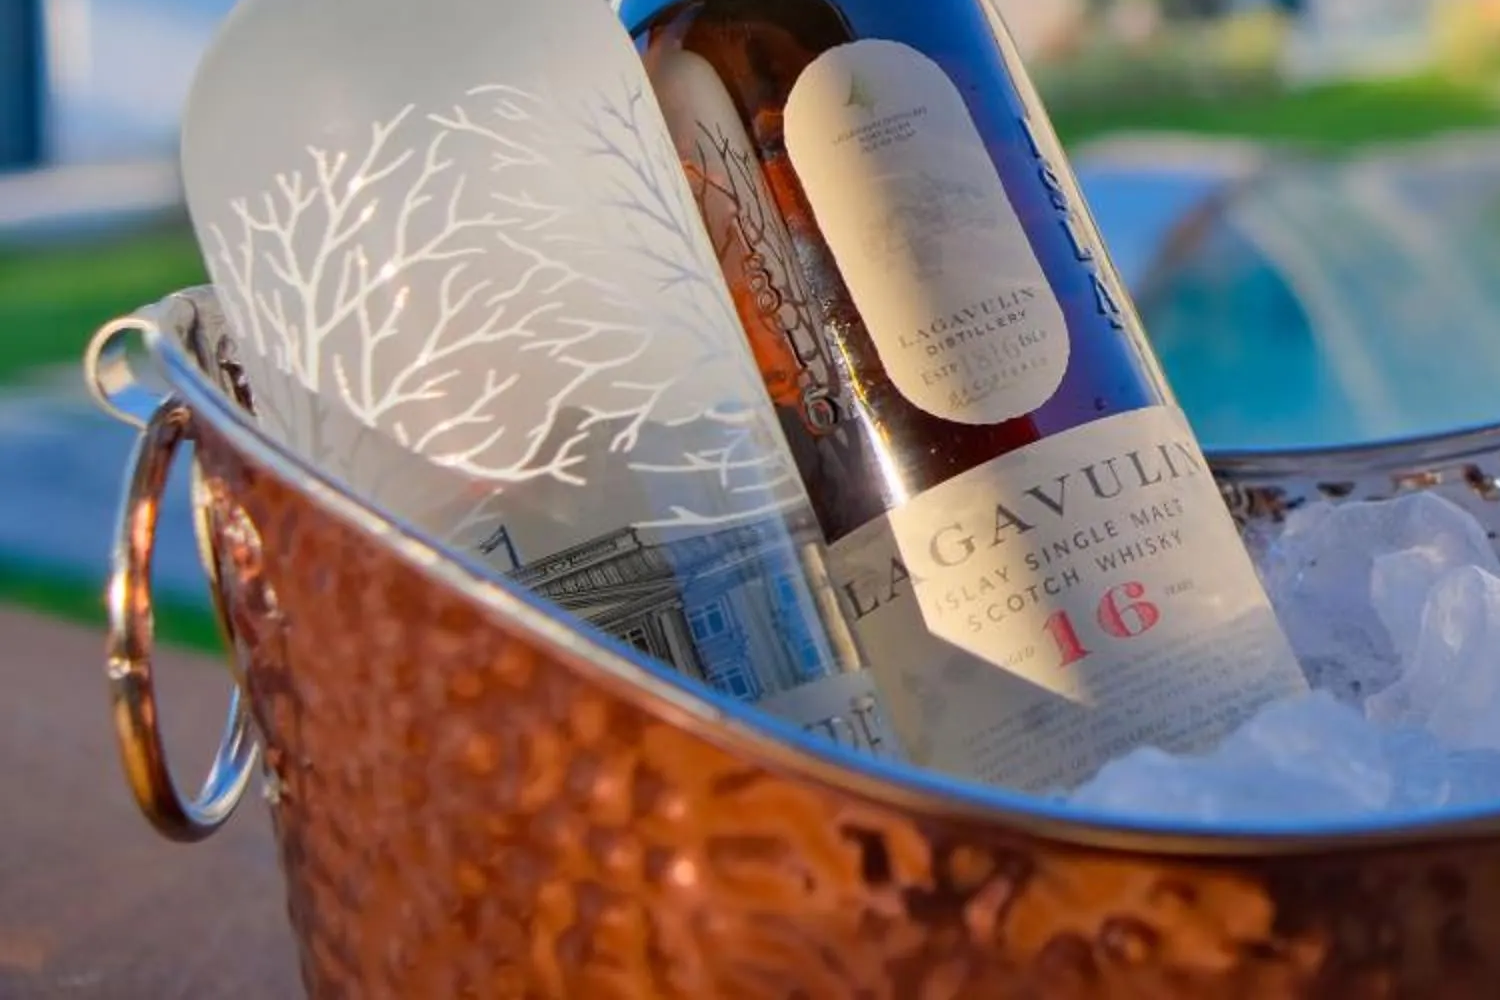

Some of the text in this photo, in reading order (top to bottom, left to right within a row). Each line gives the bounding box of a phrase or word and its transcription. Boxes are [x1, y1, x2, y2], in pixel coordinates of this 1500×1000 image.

[898, 286, 1036, 350] LAGAVULIN
[925, 310, 1027, 356] DISTILLERY
[842, 441, 1202, 622] LAGAVULIN
[935, 498, 1184, 618] ISLAY SINGLE MALT
[968, 528, 1184, 633] SCOTCH WHISKY
[1042, 579, 1162, 670] 16
